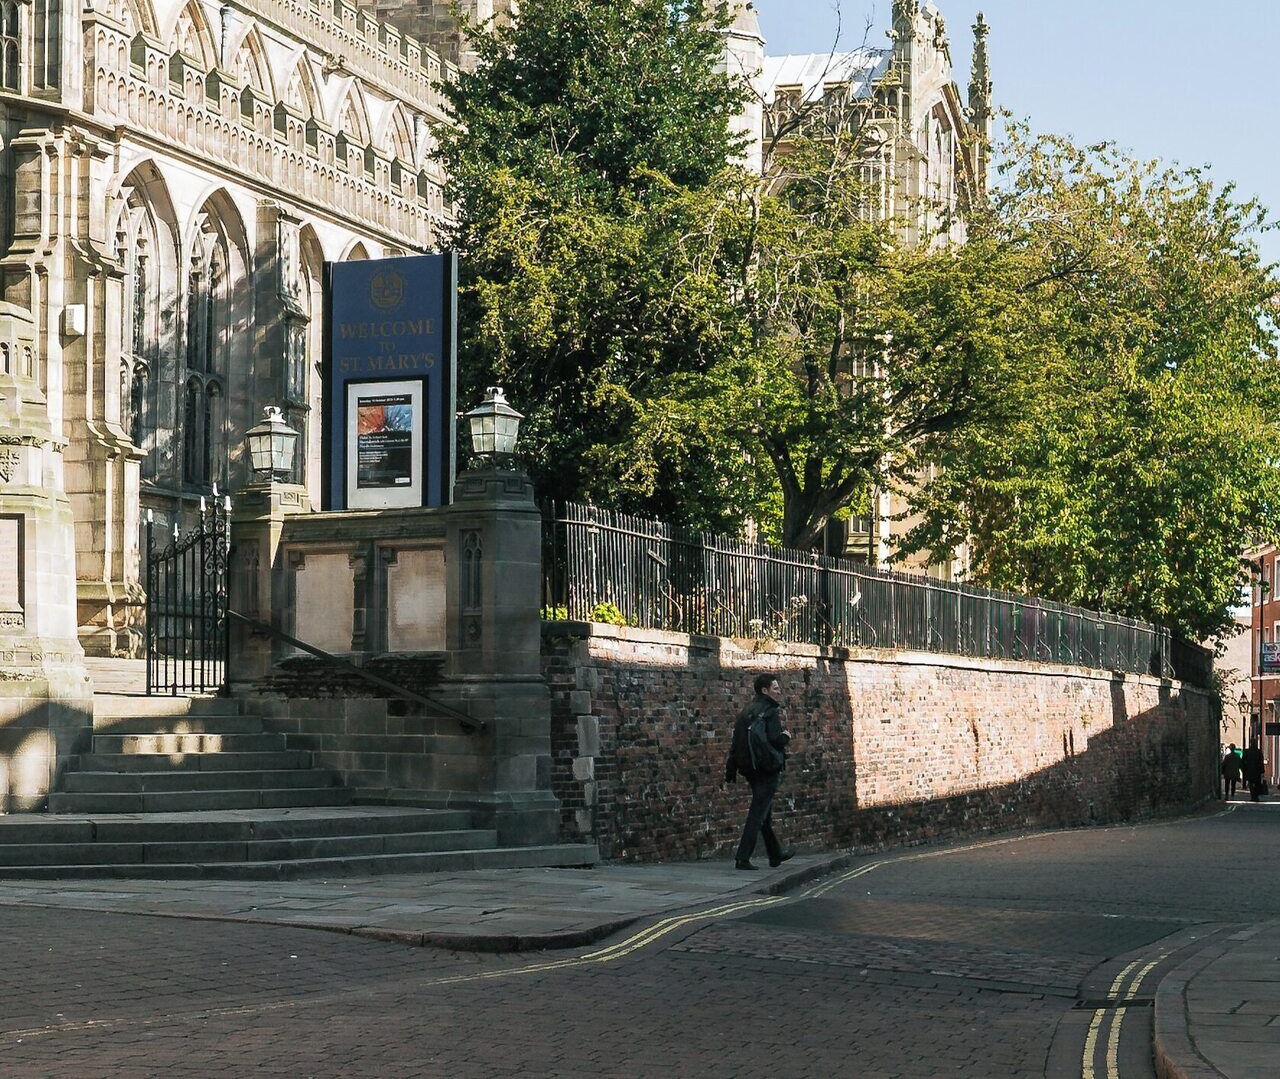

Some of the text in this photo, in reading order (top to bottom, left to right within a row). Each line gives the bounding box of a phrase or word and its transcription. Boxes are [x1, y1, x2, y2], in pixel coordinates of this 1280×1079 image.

[340, 319, 434, 340] WELCOME
[376, 340, 397, 353] TO
[367, 352, 435, 371] MARY'S
